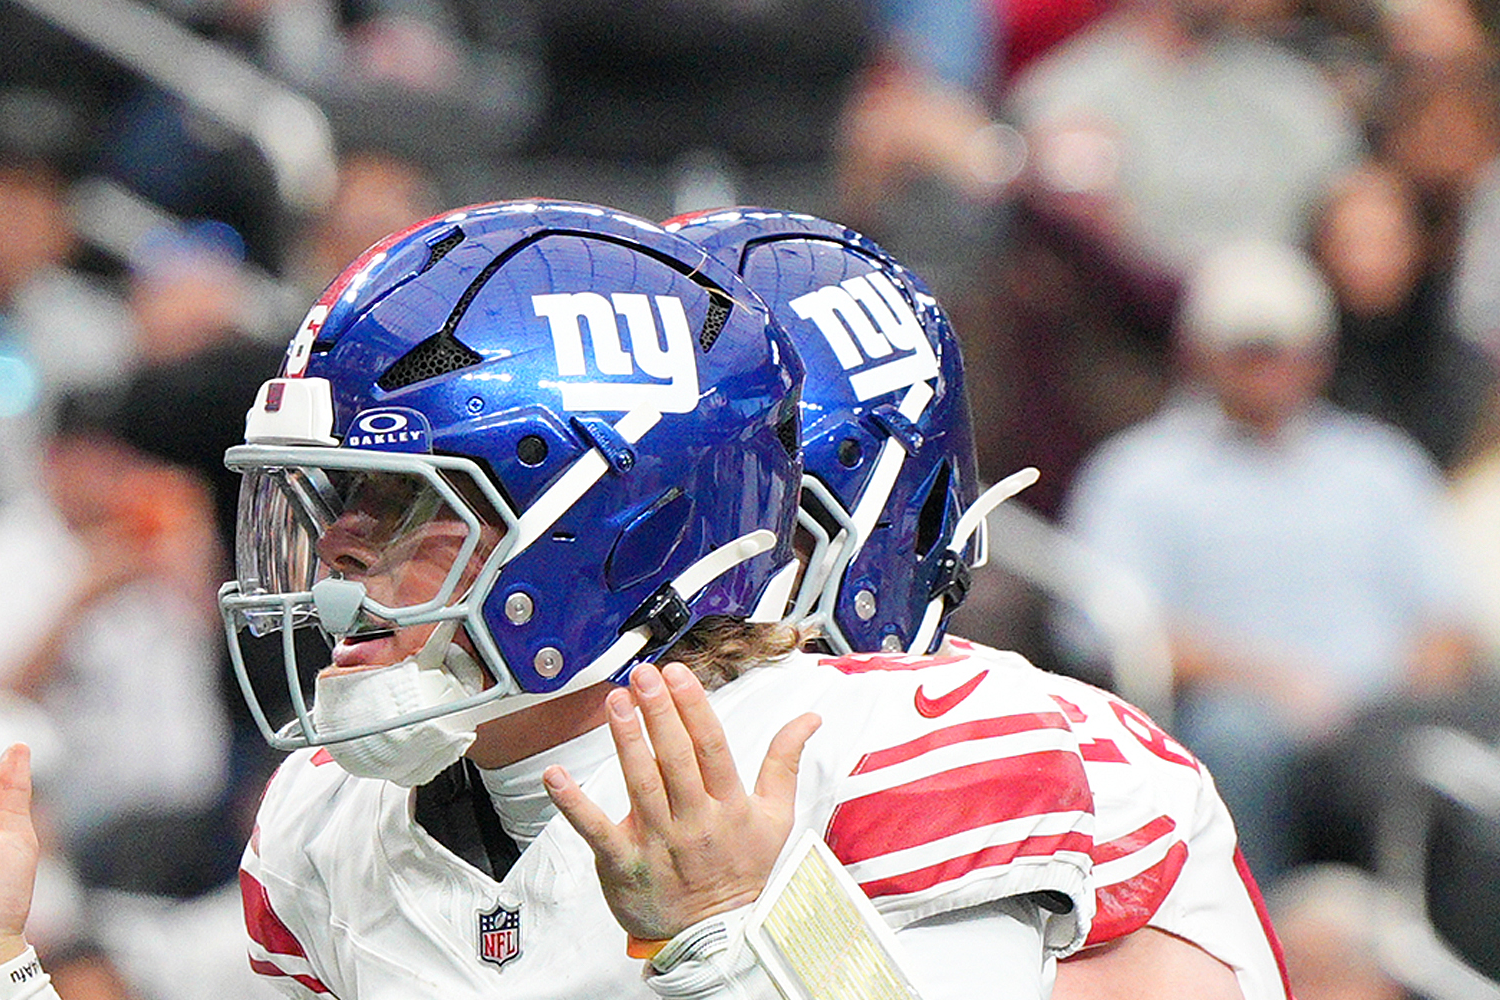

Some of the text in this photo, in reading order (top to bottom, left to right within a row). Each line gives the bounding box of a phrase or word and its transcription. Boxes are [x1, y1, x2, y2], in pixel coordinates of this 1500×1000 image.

[531, 291, 700, 414] ny
[788, 270, 939, 402] ny
[349, 430, 422, 446] OAKLEY
[484, 931, 515, 959] NFL
